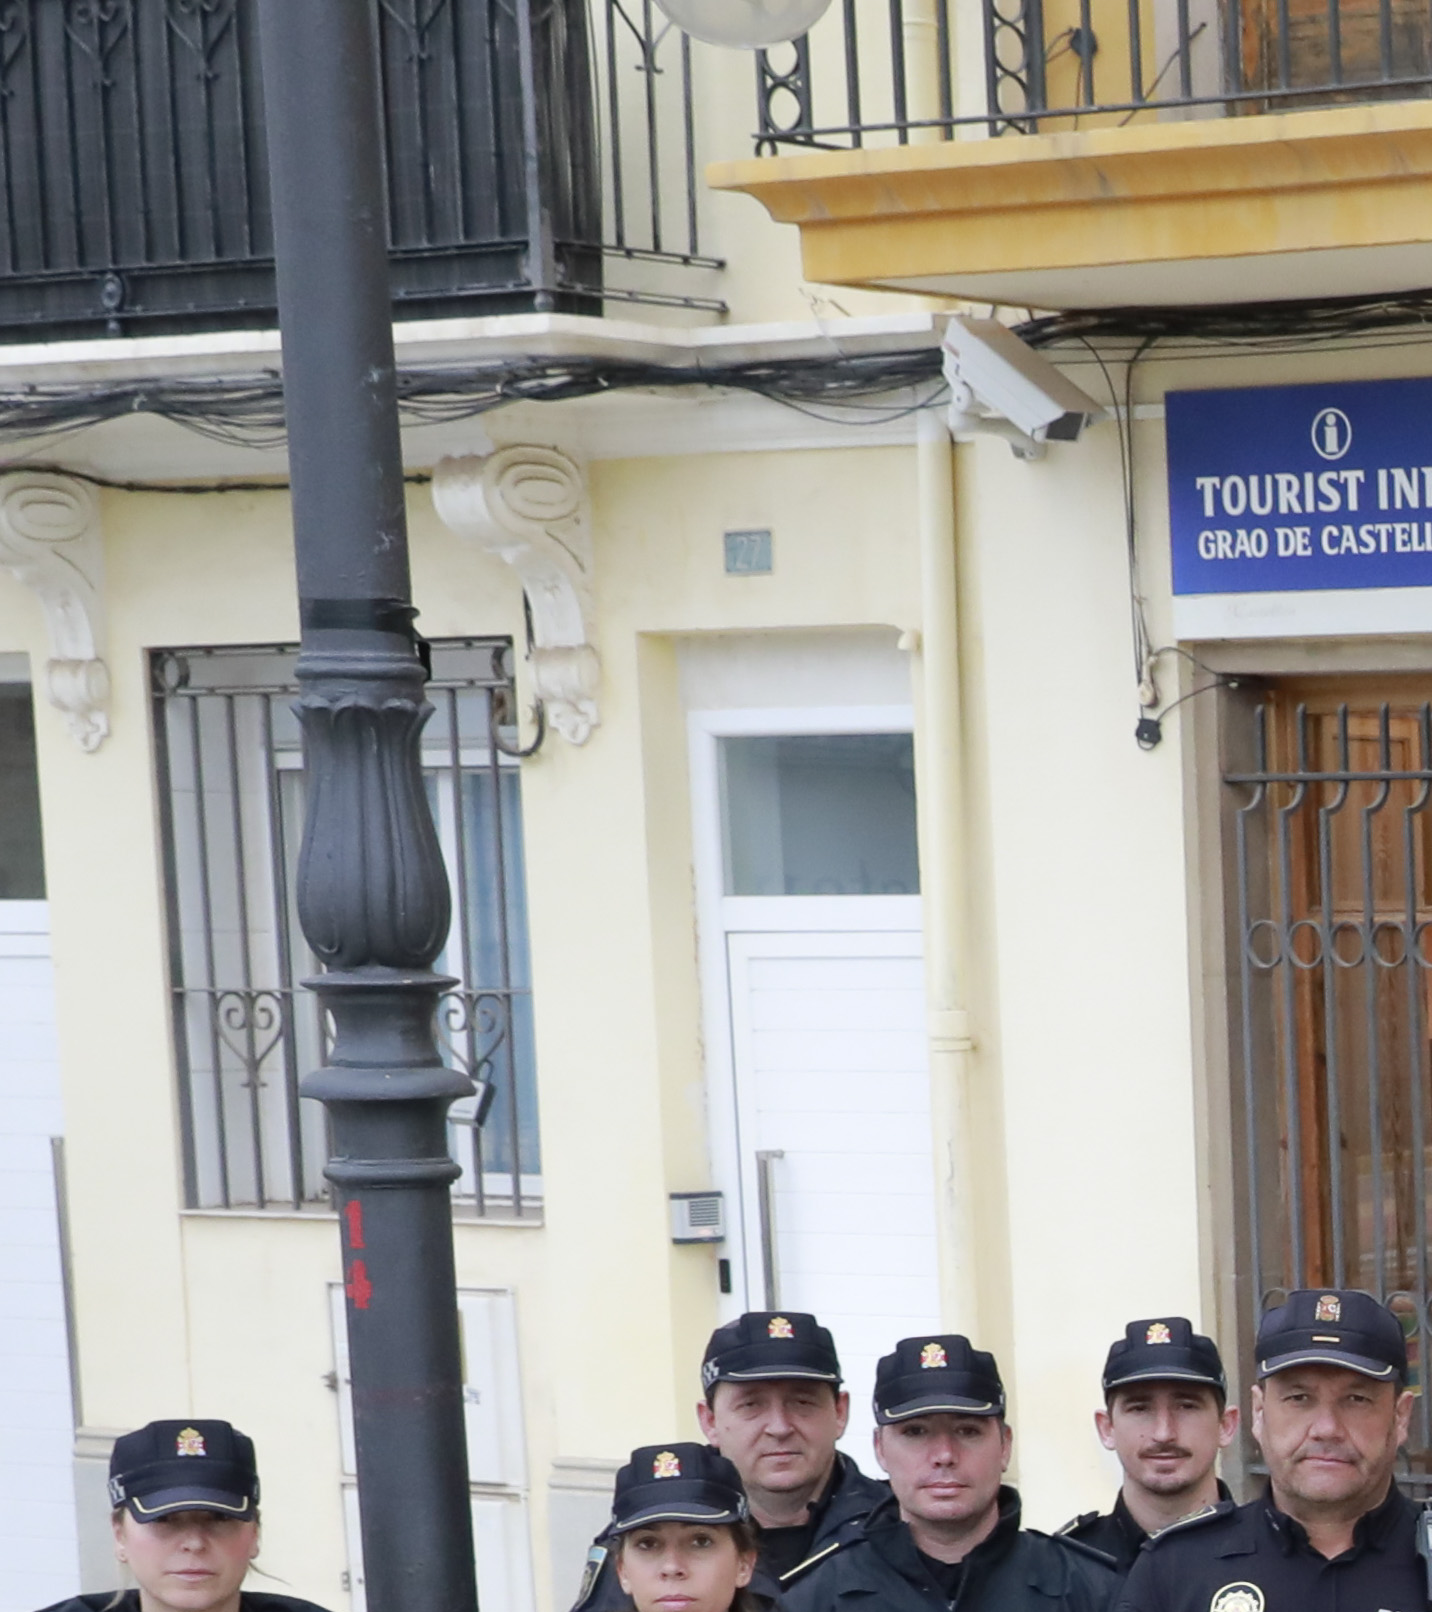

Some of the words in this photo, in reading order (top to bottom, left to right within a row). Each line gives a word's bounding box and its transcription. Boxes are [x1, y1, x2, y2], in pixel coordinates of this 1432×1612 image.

[1196, 470, 1365, 517] TOURIST
[1198, 528, 1269, 560] GRAO
[1274, 526, 1313, 557] DE
